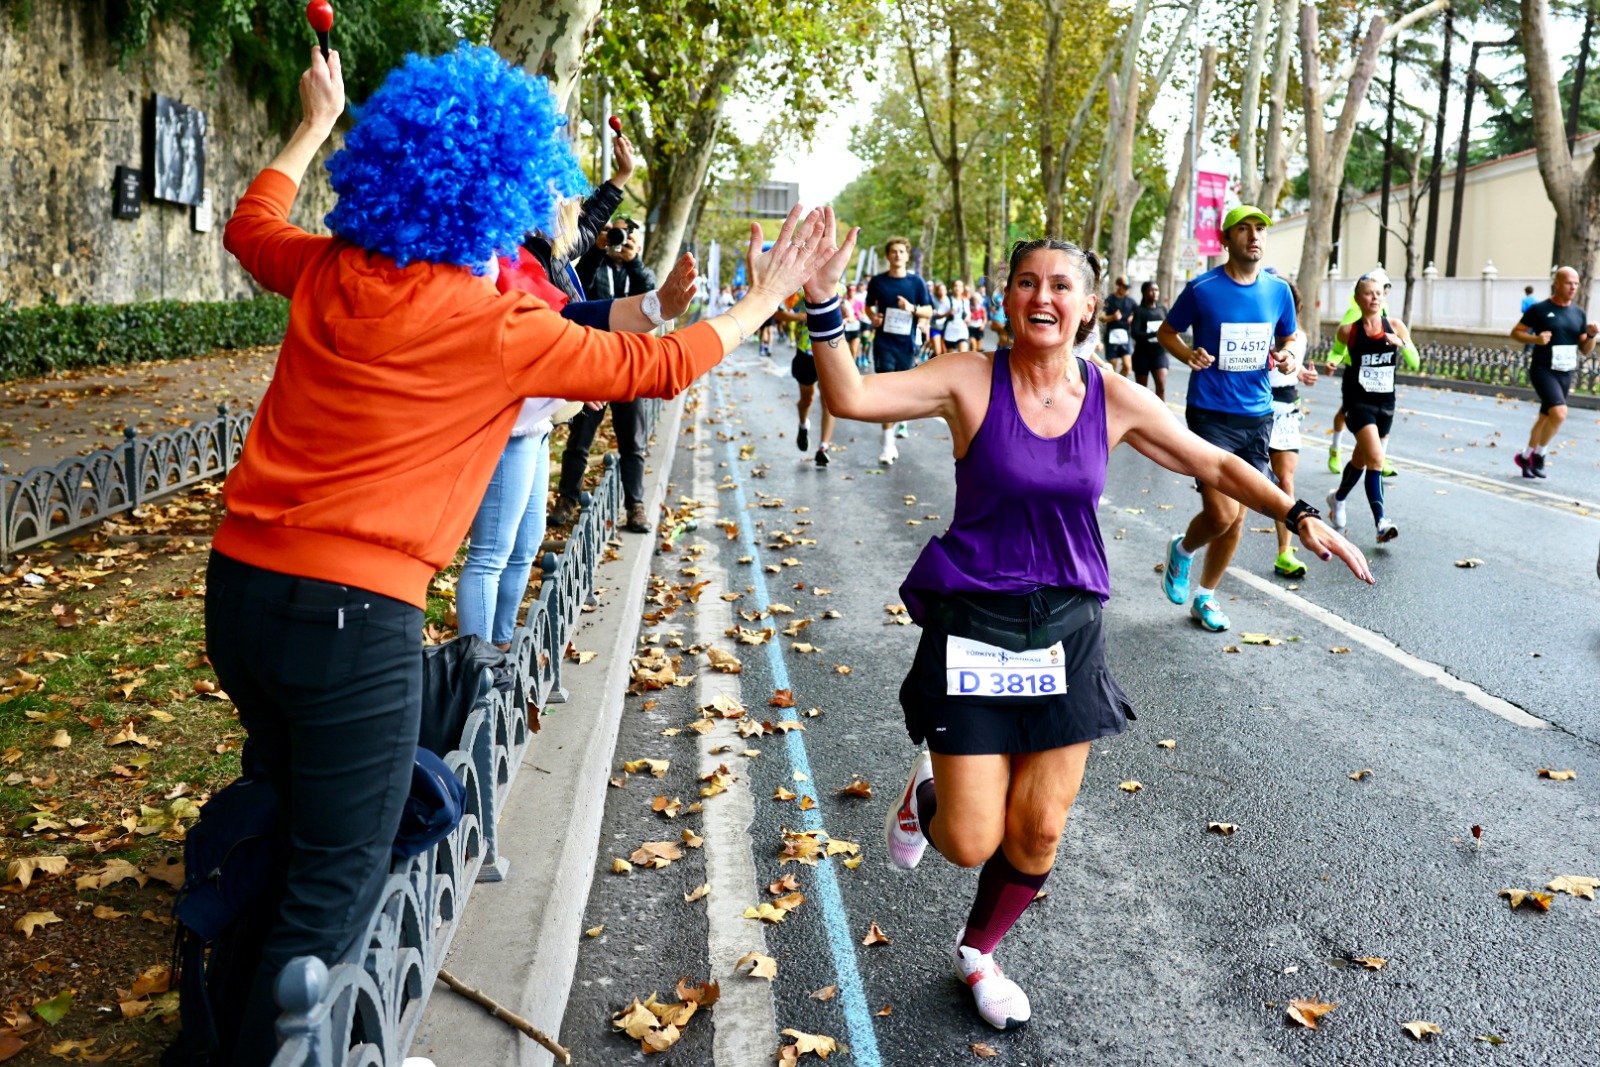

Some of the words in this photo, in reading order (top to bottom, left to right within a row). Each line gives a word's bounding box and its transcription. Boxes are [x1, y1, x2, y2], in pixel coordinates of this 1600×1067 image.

[1226, 341, 1237, 352] D
[1240, 340, 1266, 352] 4512
[1361, 351, 1394, 366] BEAT
[1363, 370, 1371, 378] D
[960, 671, 980, 693] D
[990, 672, 1057, 694] 3818
